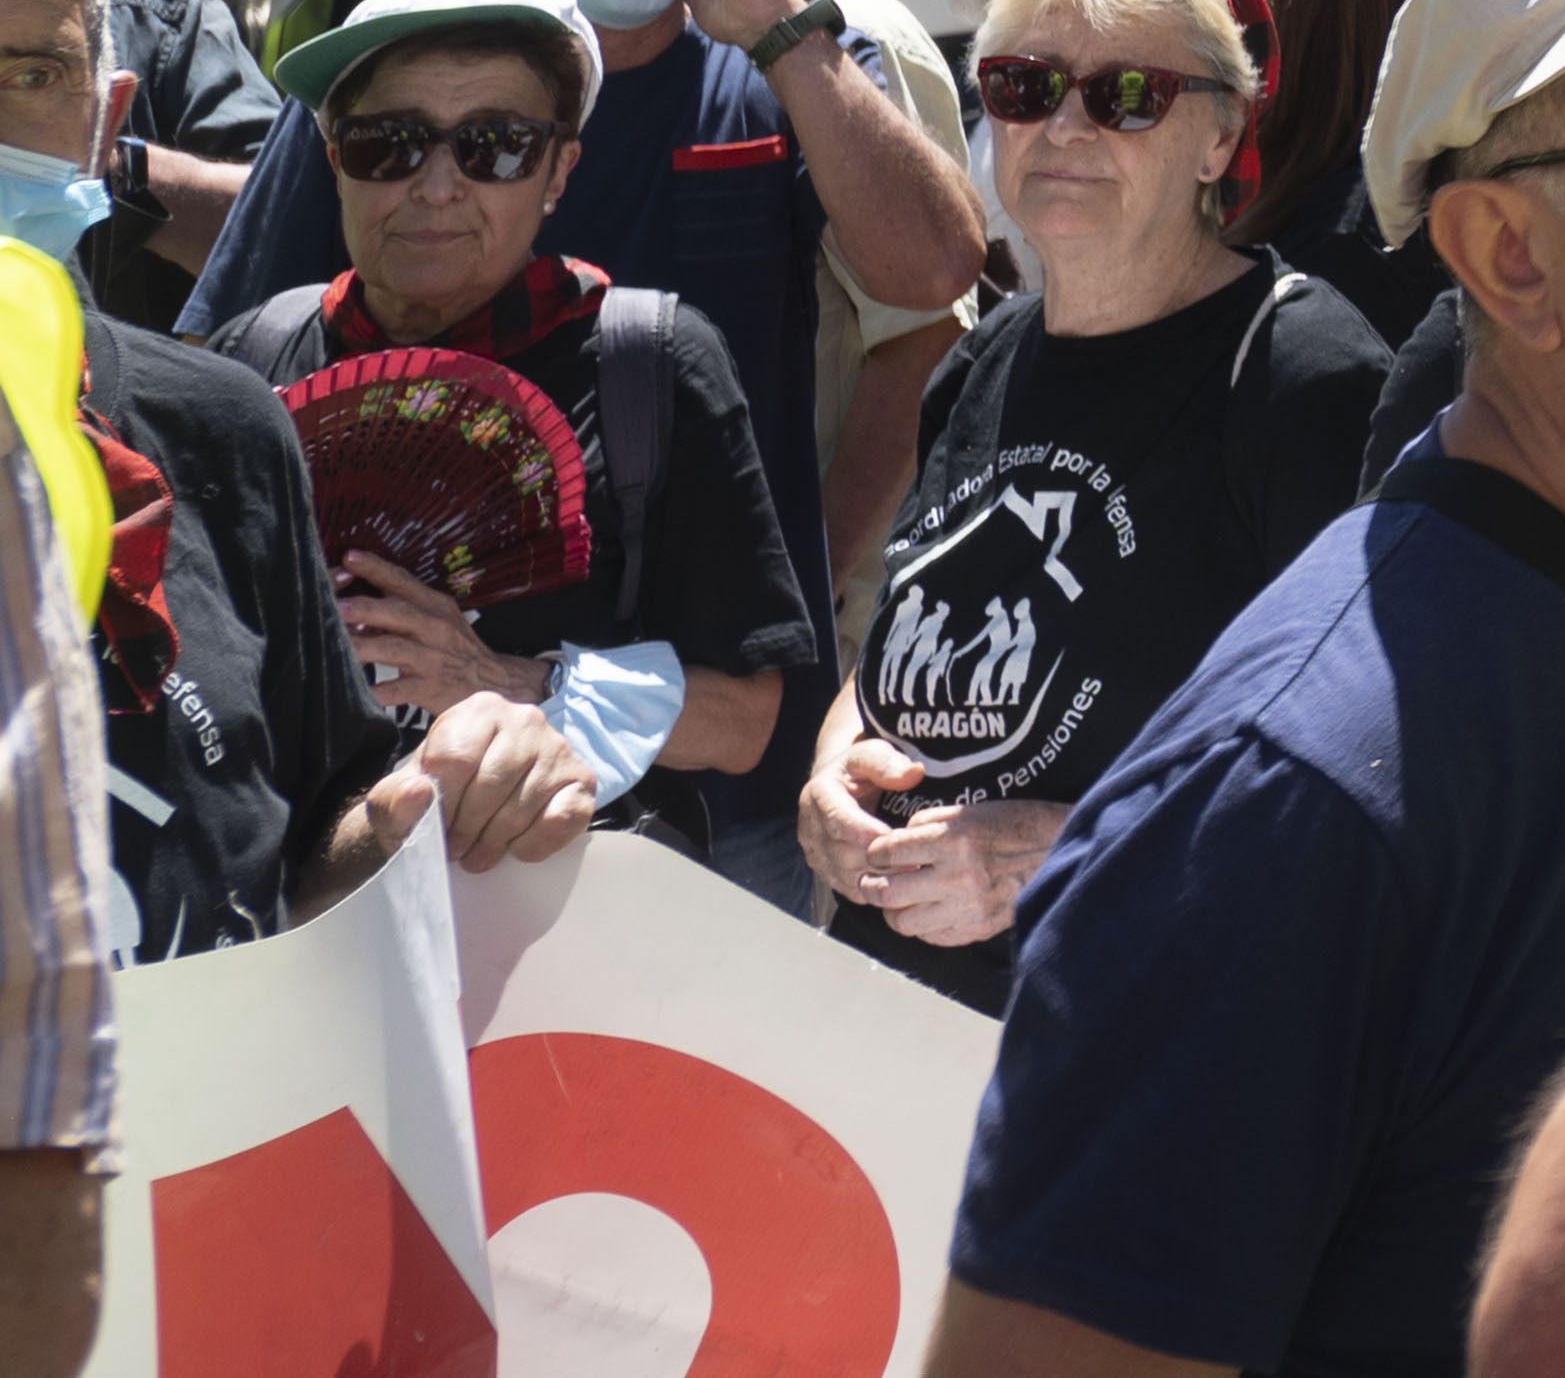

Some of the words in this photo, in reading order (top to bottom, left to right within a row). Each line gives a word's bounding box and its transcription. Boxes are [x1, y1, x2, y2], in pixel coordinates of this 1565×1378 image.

[1050, 447, 1093, 472] por
[1088, 463, 1113, 492] la
[160, 670, 228, 767] efensa
[897, 706, 1006, 739] ARAGÓN
[997, 675, 1103, 799] Pensiones
